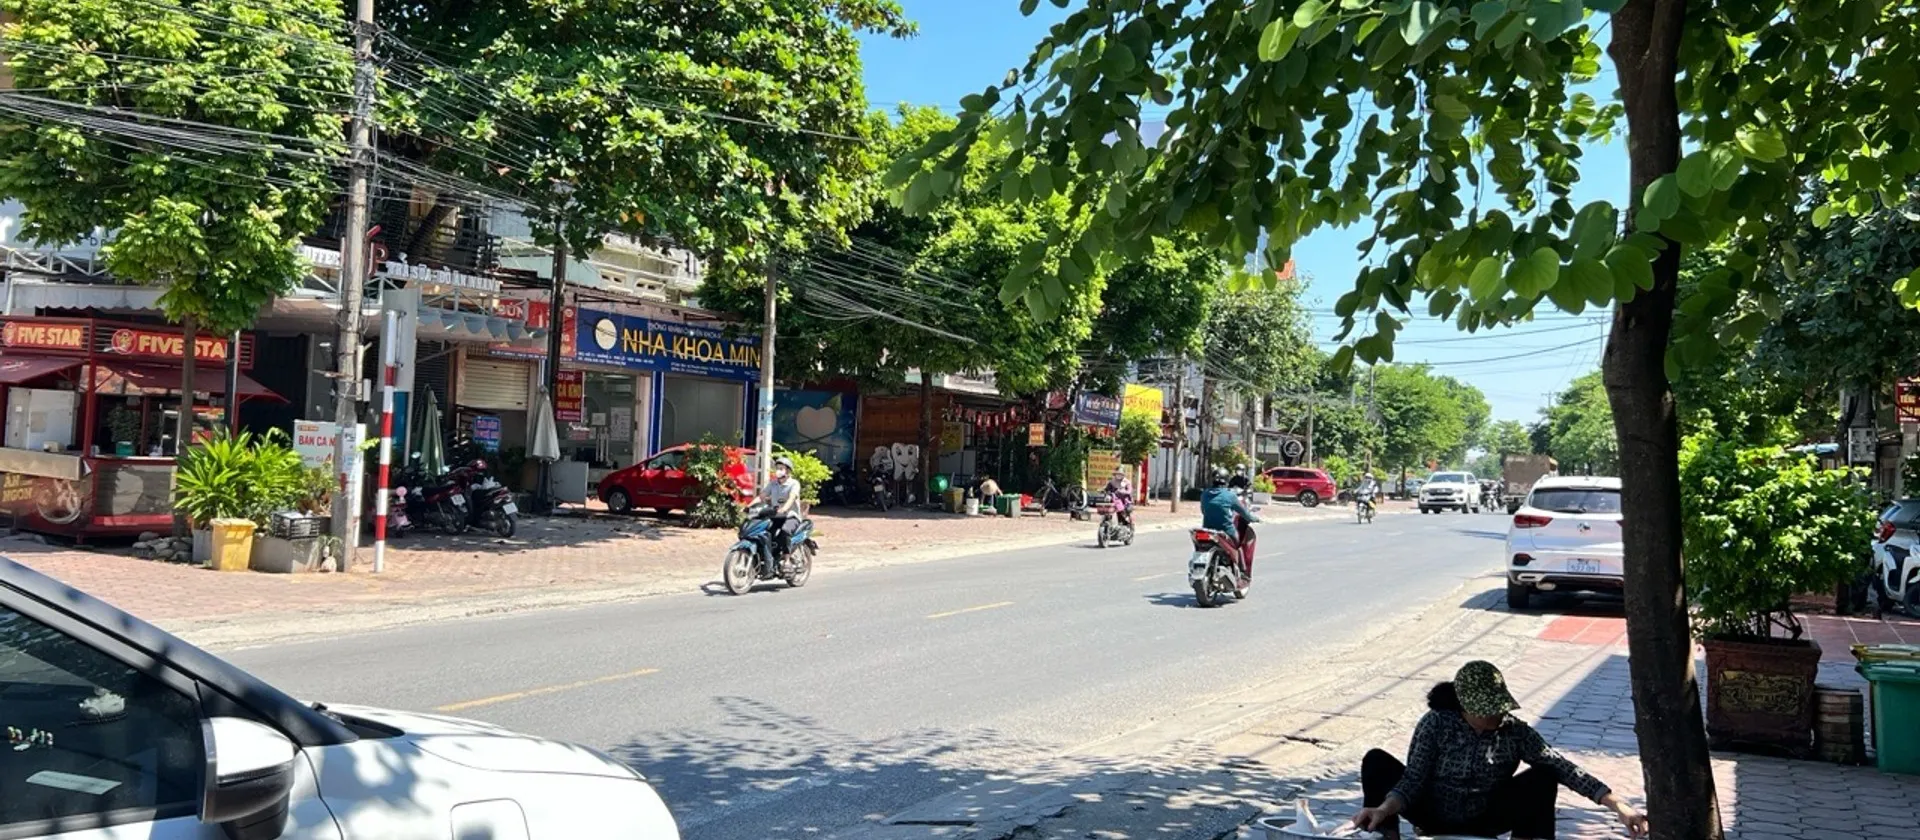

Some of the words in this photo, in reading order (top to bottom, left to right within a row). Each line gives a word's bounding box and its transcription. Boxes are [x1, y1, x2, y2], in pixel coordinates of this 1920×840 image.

[17, 326, 46, 345] FIVE
[46, 327, 82, 346] STAR
[138, 335, 184, 356] FIVE
[193, 340, 227, 360] STA
[622, 328, 668, 358] NHA
[672, 335, 726, 365] KHOA
[729, 343, 762, 369] MIN
